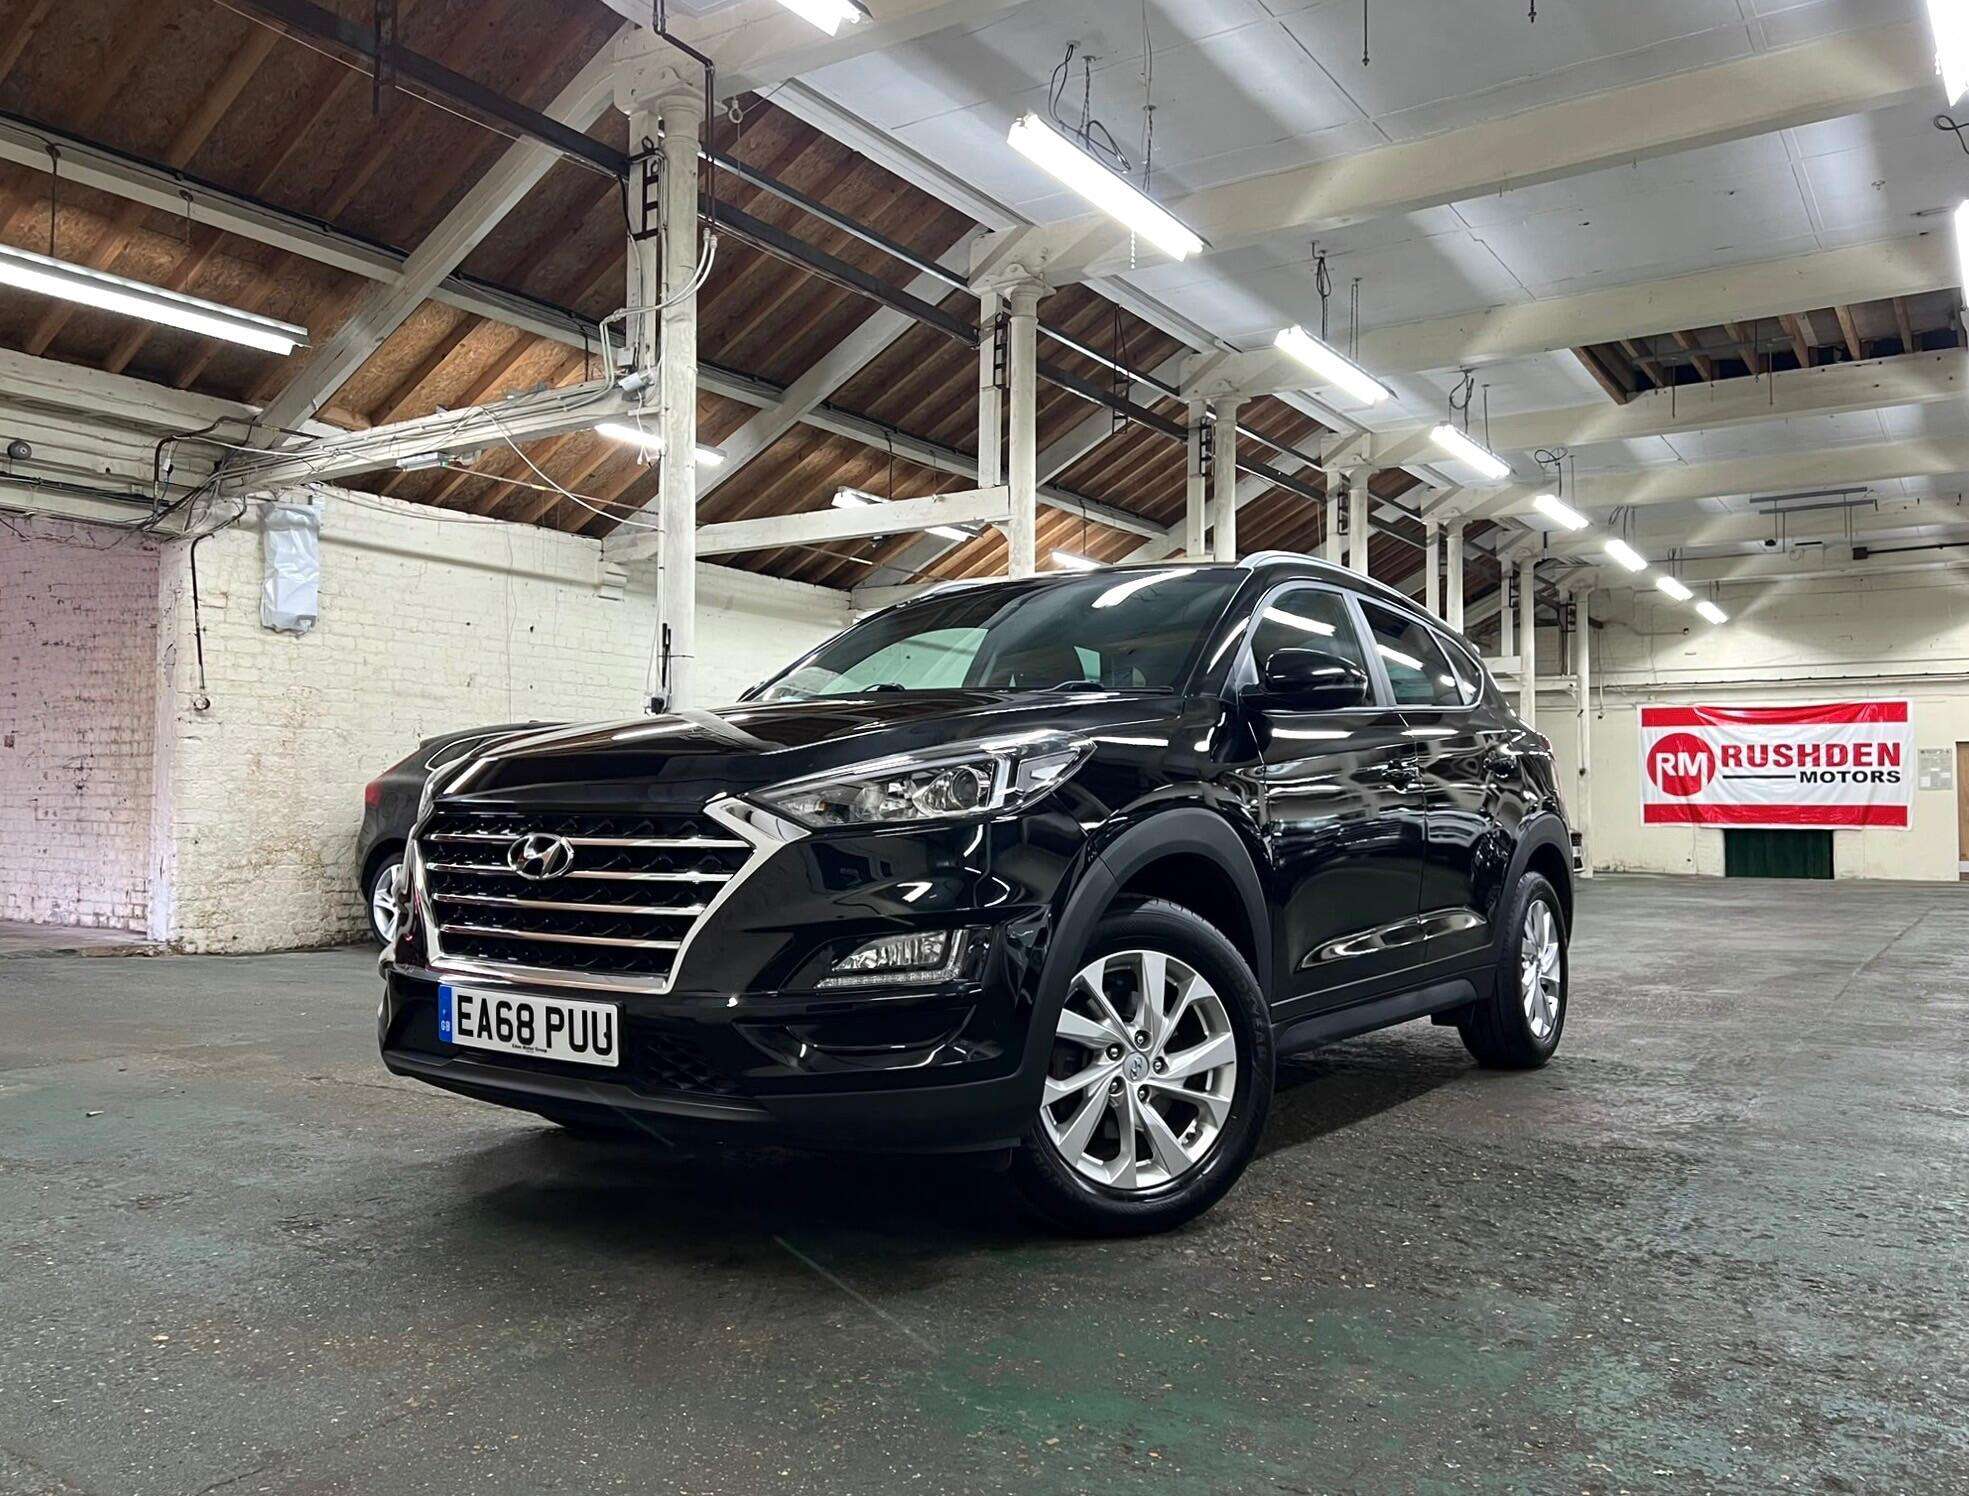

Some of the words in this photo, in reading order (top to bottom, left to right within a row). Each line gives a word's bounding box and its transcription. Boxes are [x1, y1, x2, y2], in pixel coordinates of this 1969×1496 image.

[1720, 742, 1901, 768] RUSHDEN
[1656, 751, 1708, 787] RM
[1799, 769, 1901, 784] MOTORS
[440, 1019, 451, 1032] GB
[457, 994, 535, 1046] EA68
[545, 1005, 613, 1056] PUU
